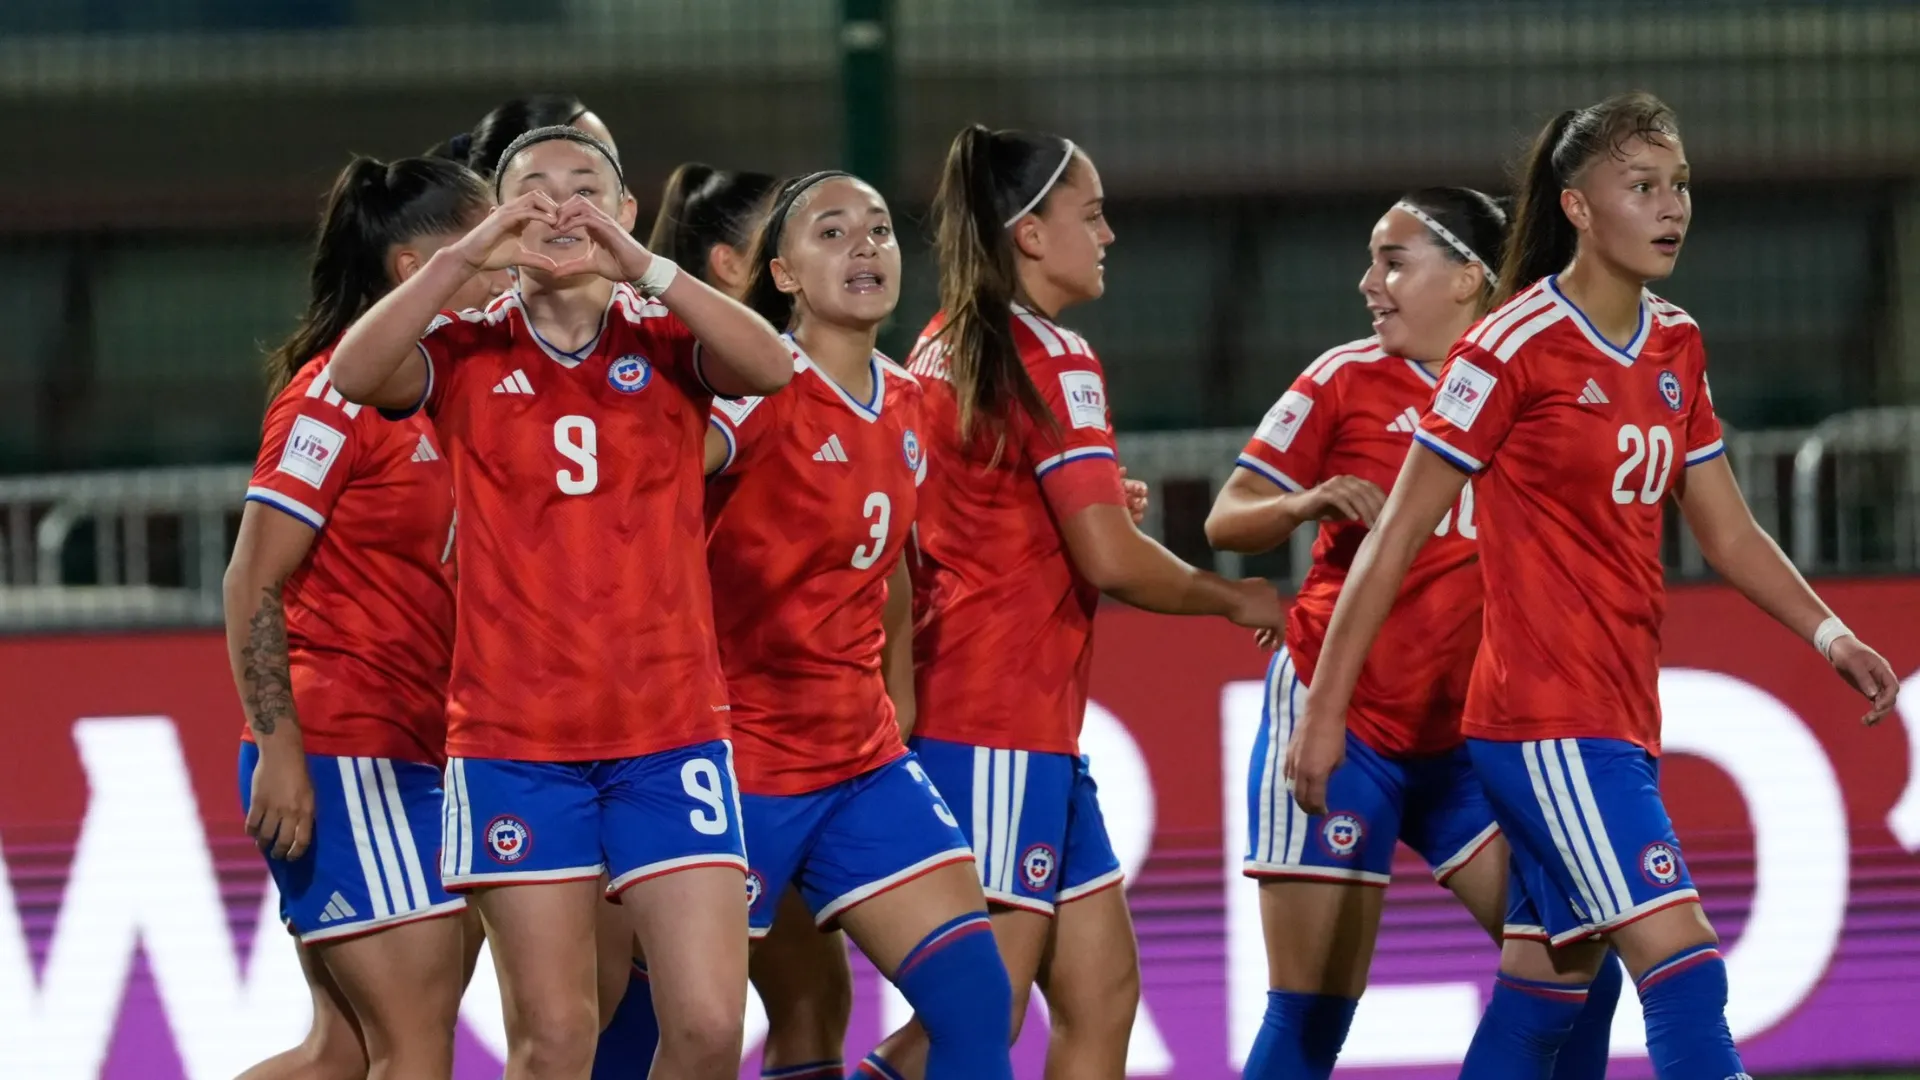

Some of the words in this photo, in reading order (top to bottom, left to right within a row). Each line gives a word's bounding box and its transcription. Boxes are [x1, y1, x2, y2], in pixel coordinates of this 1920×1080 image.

[1448, 378, 1479, 403] U17
[294, 435, 329, 462] U17
[554, 415, 598, 495] 9
[1612, 424, 1673, 505] 20
[851, 491, 891, 570] 3
[680, 758, 728, 835] 9
[906, 760, 959, 828] 3
